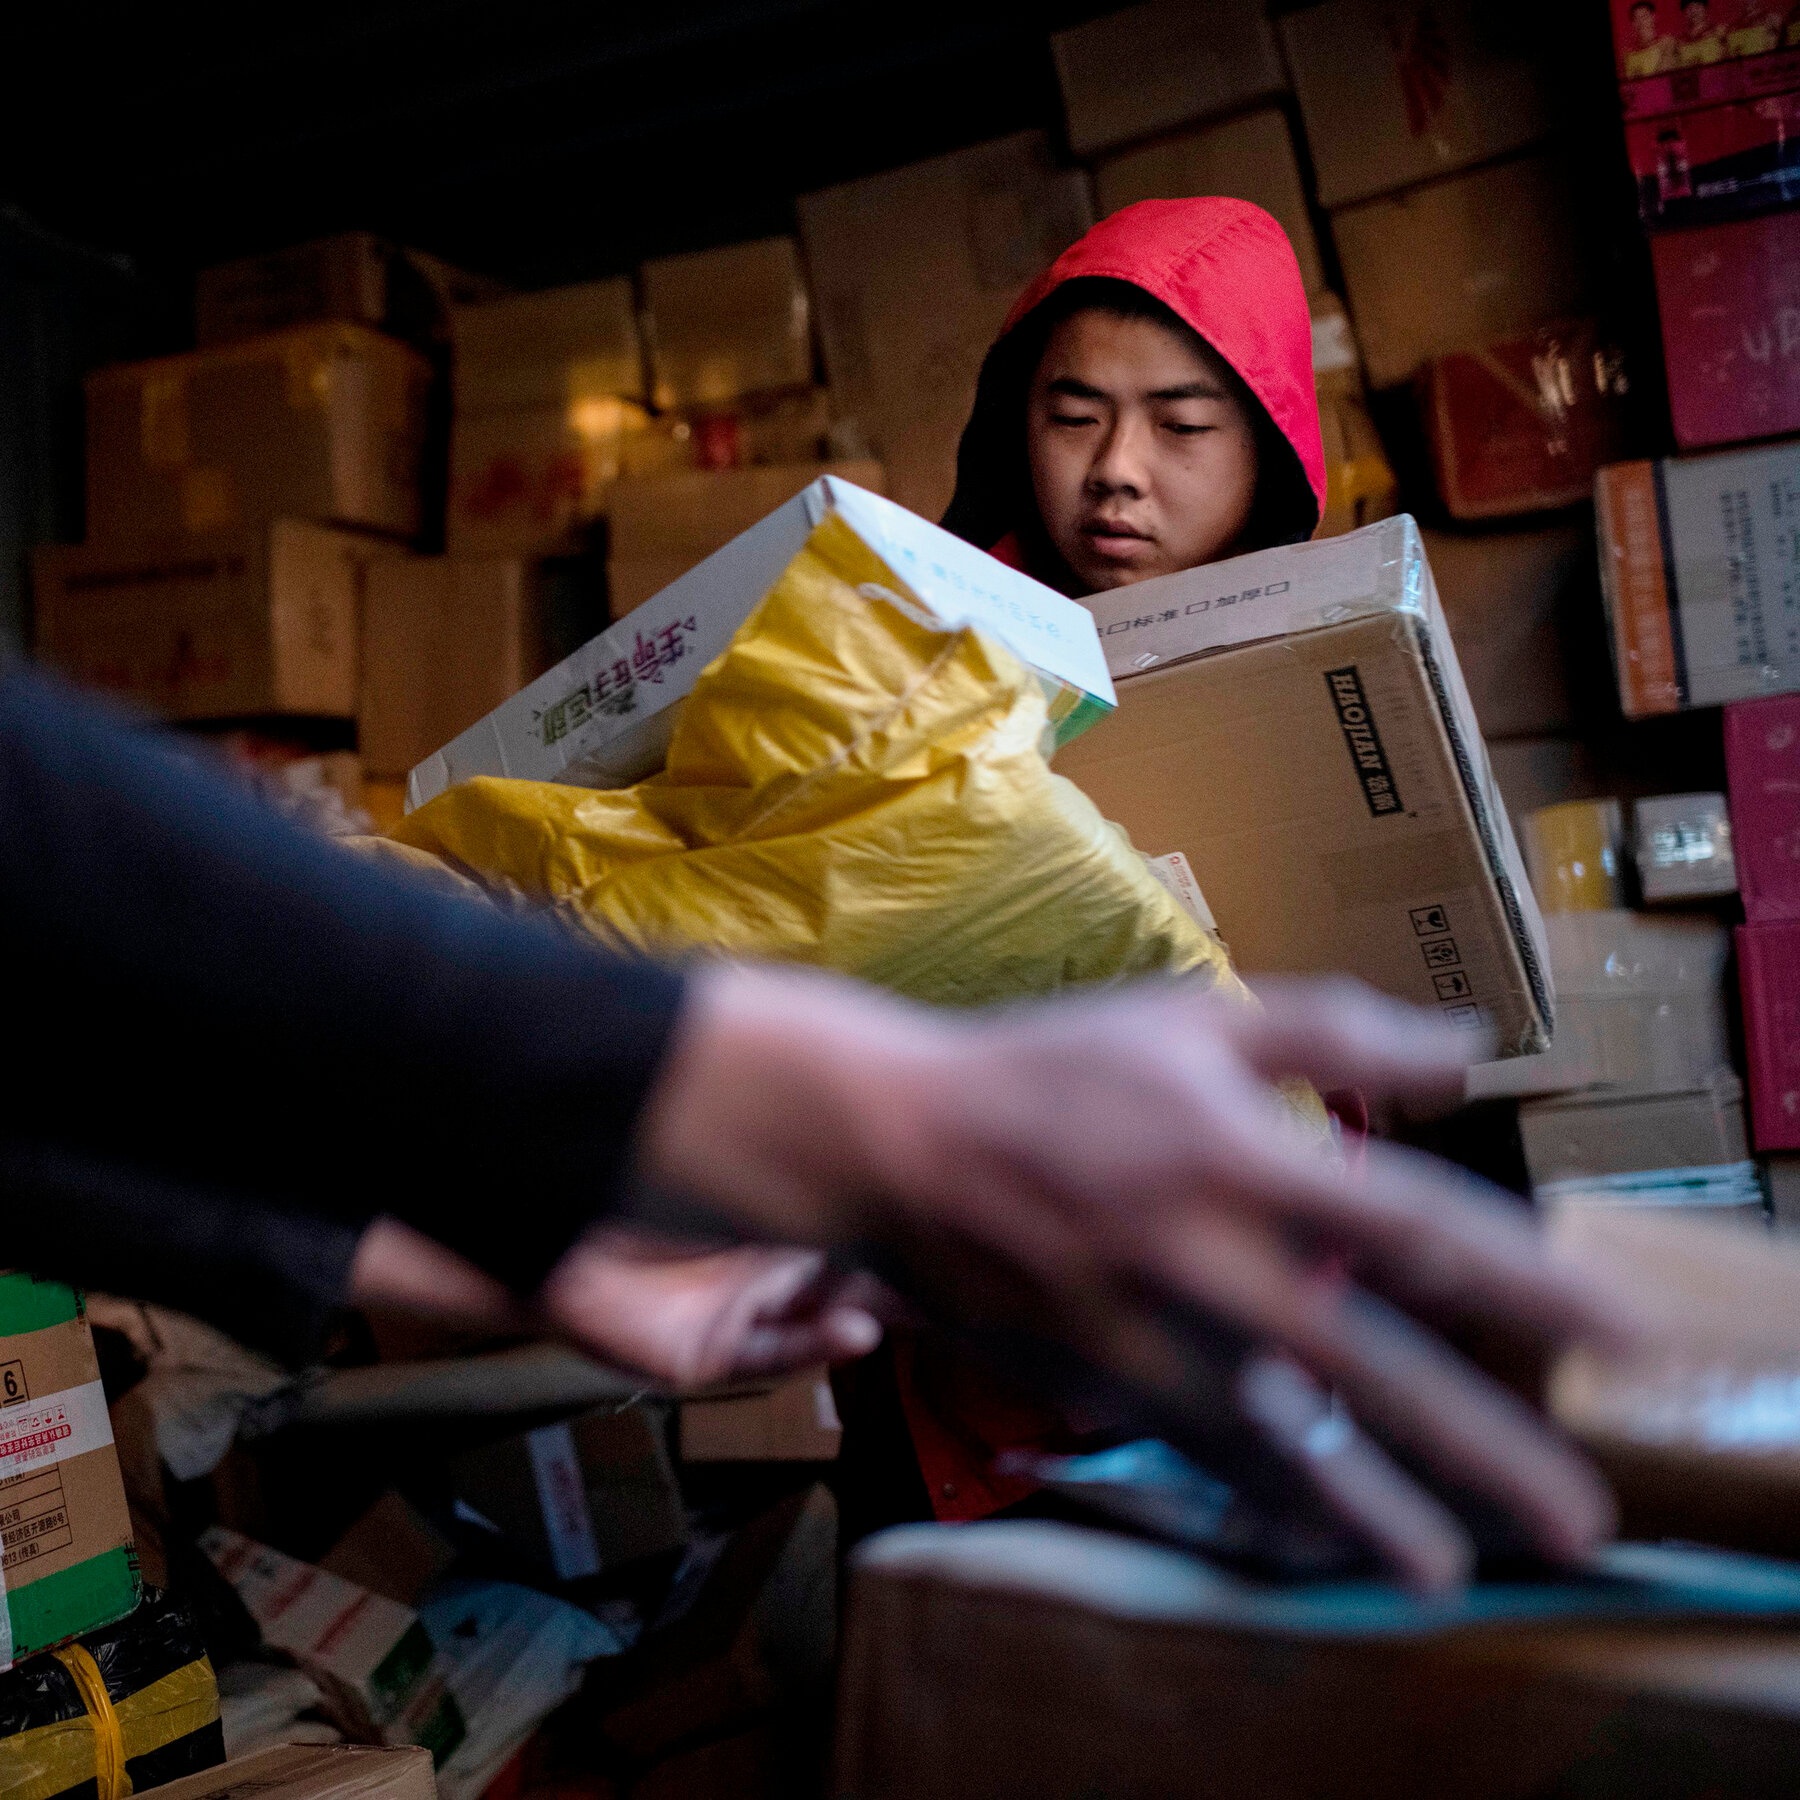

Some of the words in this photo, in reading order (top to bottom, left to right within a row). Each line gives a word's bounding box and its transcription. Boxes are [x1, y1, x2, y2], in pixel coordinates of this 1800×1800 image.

[1213, 587, 1262, 609] 加厚
[1133, 609, 1178, 628] 标准
[1331, 673, 1383, 771] HAOJIAN
[4, 1370, 18, 1397] 6
